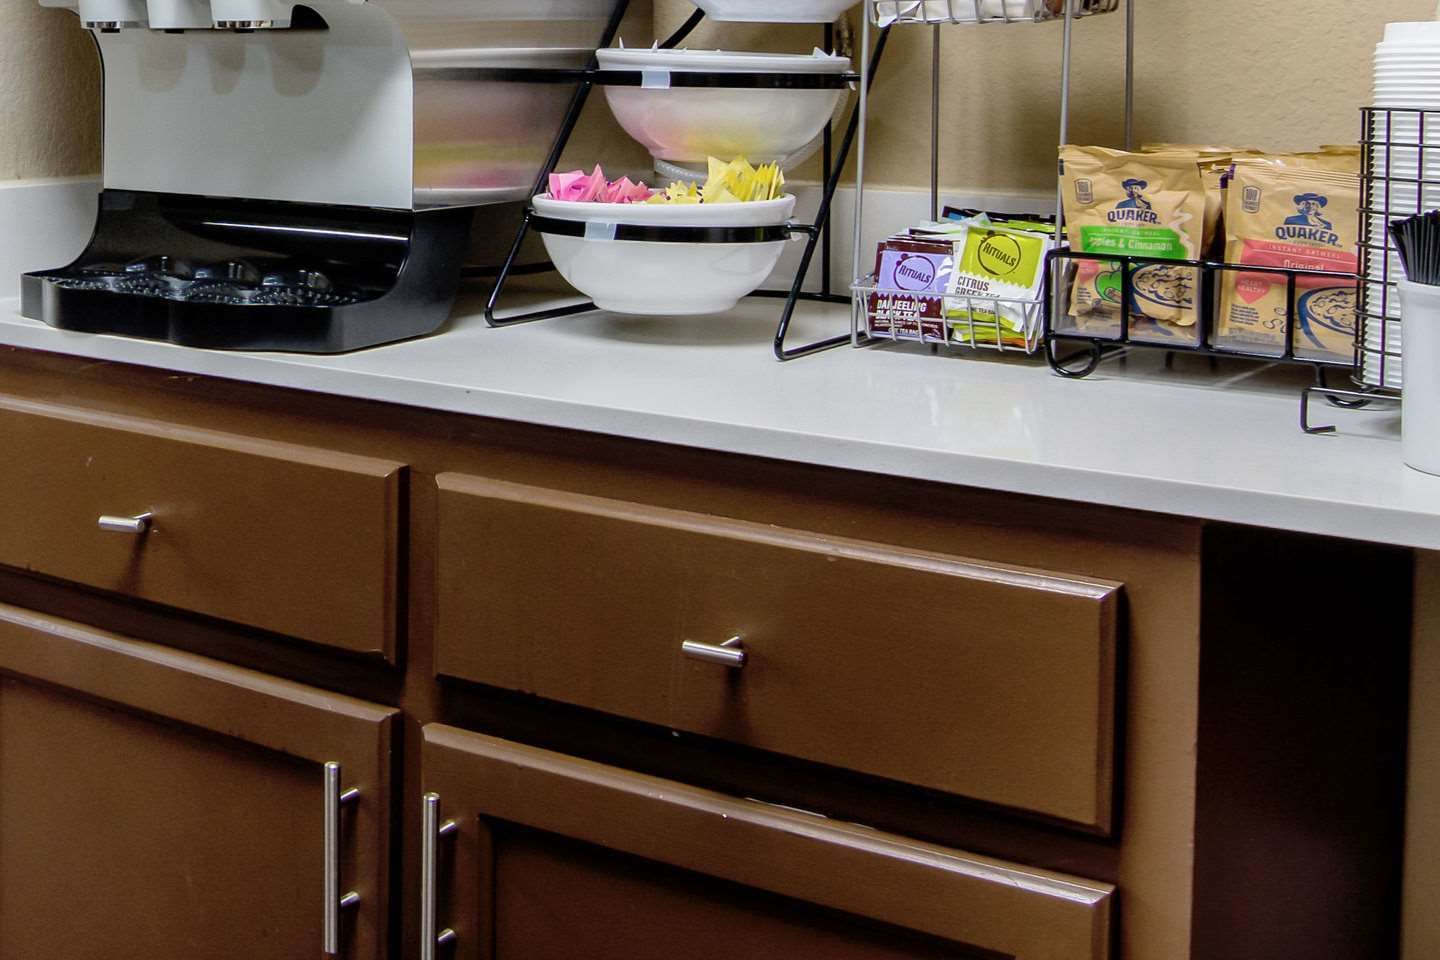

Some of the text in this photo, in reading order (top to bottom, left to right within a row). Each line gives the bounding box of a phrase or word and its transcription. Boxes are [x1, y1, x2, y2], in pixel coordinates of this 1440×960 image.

[1107, 209, 1157, 224] QUAKER
[1275, 226, 1338, 246] QUAKER
[1128, 239, 1173, 251] Cinnamon
[982, 242, 1016, 267] RITUALS
[1283, 259, 1325, 271] Original
[898, 265, 931, 284] RITUALS
[957, 275, 990, 291] CITRUS
[876, 299, 928, 313] DAJEELIG
